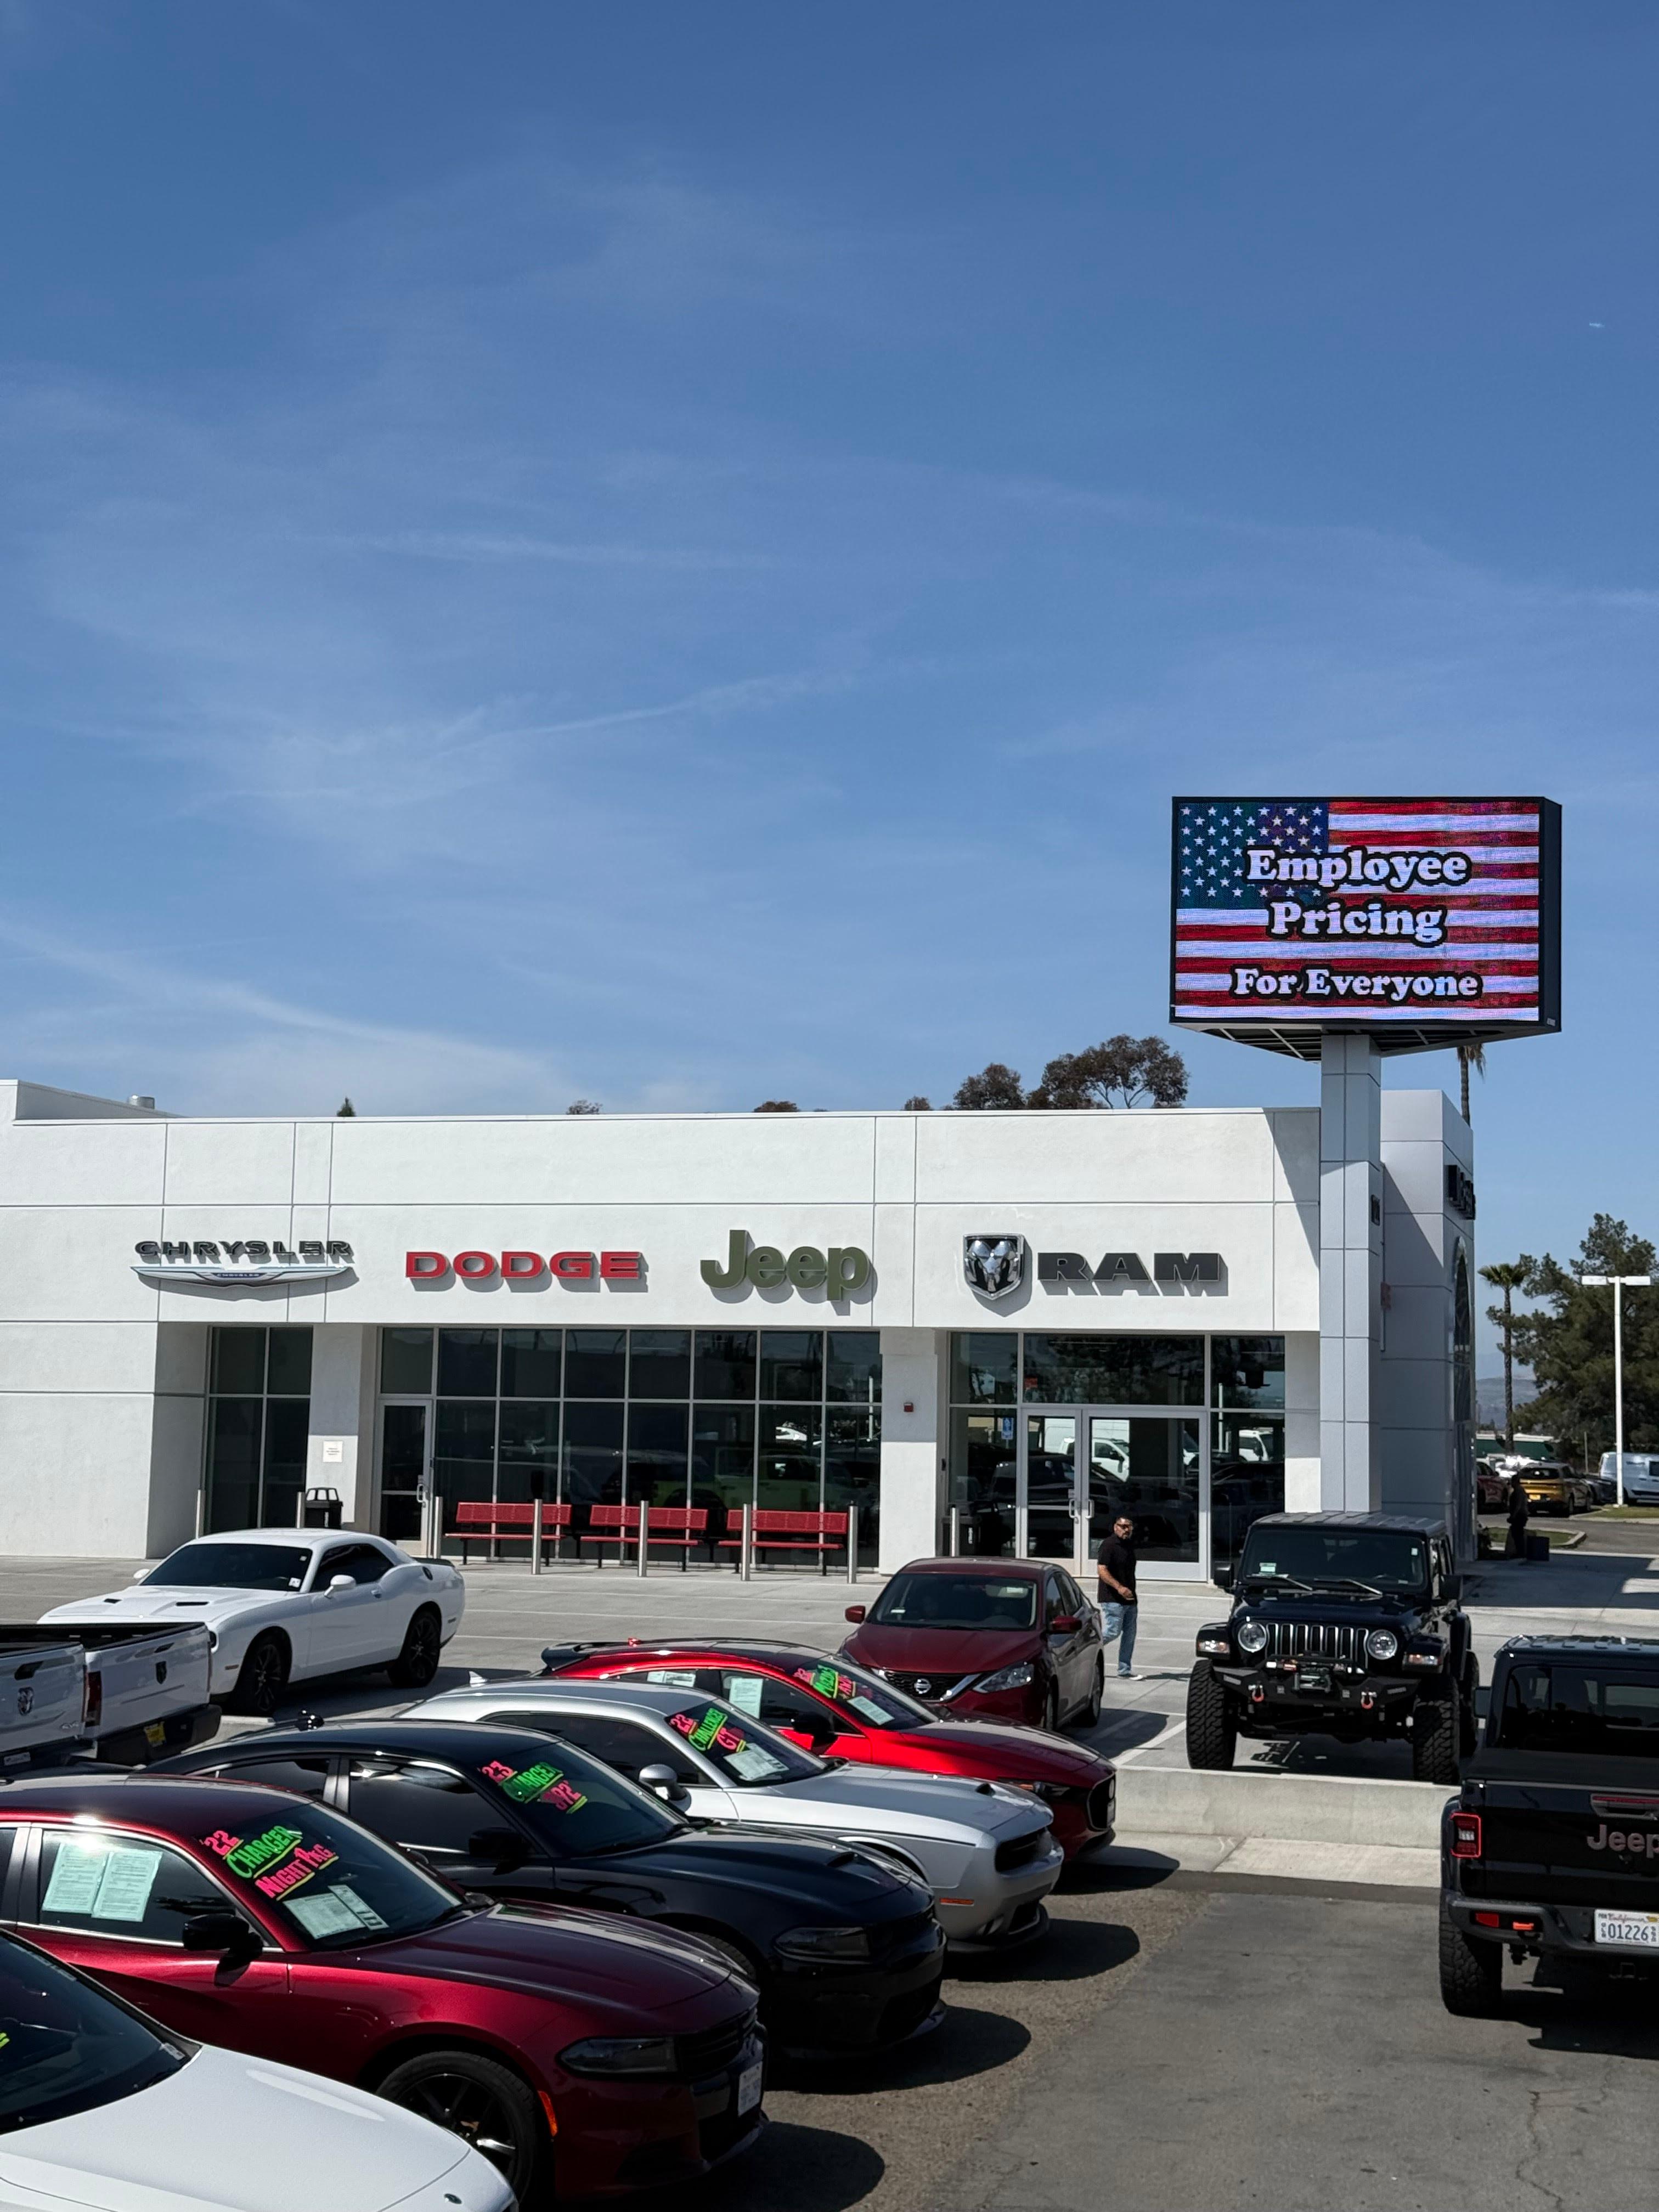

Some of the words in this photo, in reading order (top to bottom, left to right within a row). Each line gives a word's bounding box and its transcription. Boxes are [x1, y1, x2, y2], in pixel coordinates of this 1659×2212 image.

[1247, 849, 1468, 888] Employee
[1271, 902, 1443, 943] Pricing
[1233, 968, 1297, 996] For
[1305, 968, 1477, 1002] Everyone
[134, 1240, 351, 1256] CHRYSLER
[405, 1251, 642, 1279] DODGE
[699, 1229, 871, 1301] Jeep
[1037, 1252, 1221, 1282] RAM
[716, 1727, 740, 1750] GT
[227, 1825, 302, 1878] CHARGER
[1587, 1824, 1659, 1859] Jeep
[255, 1859, 312, 1898] NIGHT
[1607, 1923, 1649, 1942] 01226
